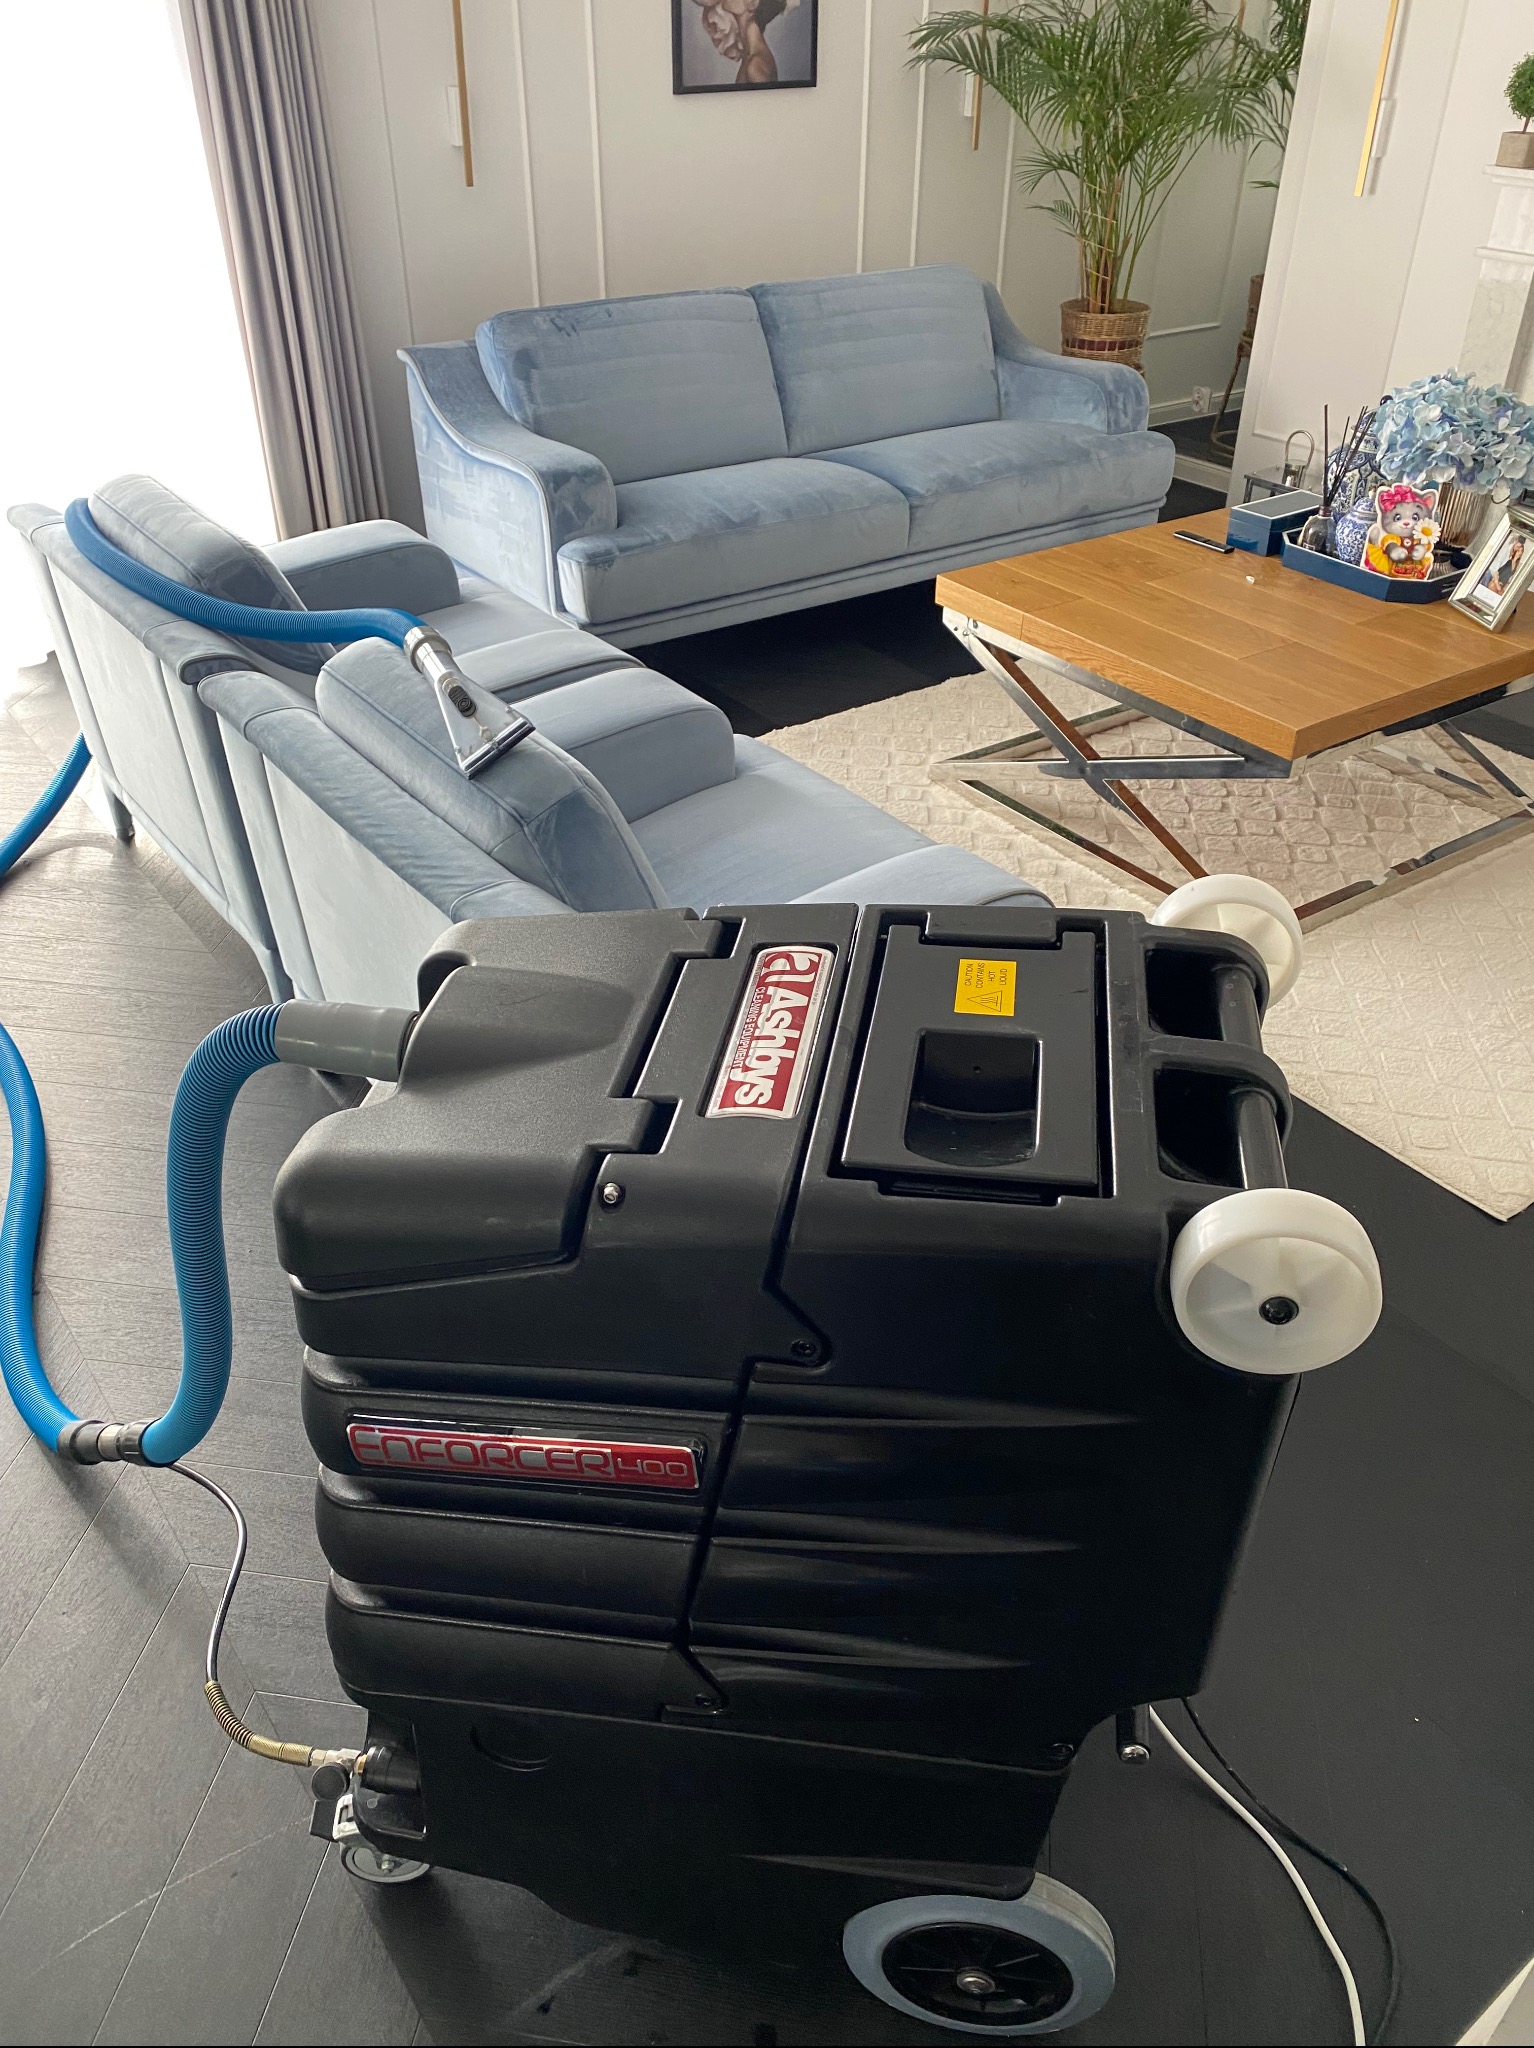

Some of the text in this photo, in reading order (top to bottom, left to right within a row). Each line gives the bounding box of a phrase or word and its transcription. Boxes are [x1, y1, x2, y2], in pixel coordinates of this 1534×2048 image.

[964, 963, 974, 987] CAUTION
[975, 962, 986, 989] CONTAINS
[987, 970, 996, 982] HOT
[998, 968, 1008, 986] LIQUID
[745, 986, 766, 1023] CLEANING
[730, 986, 809, 1105] Ashbys
[731, 1023, 756, 1069] EQUIPMENT
[349, 1424, 688, 1478] ENFORCER 400
